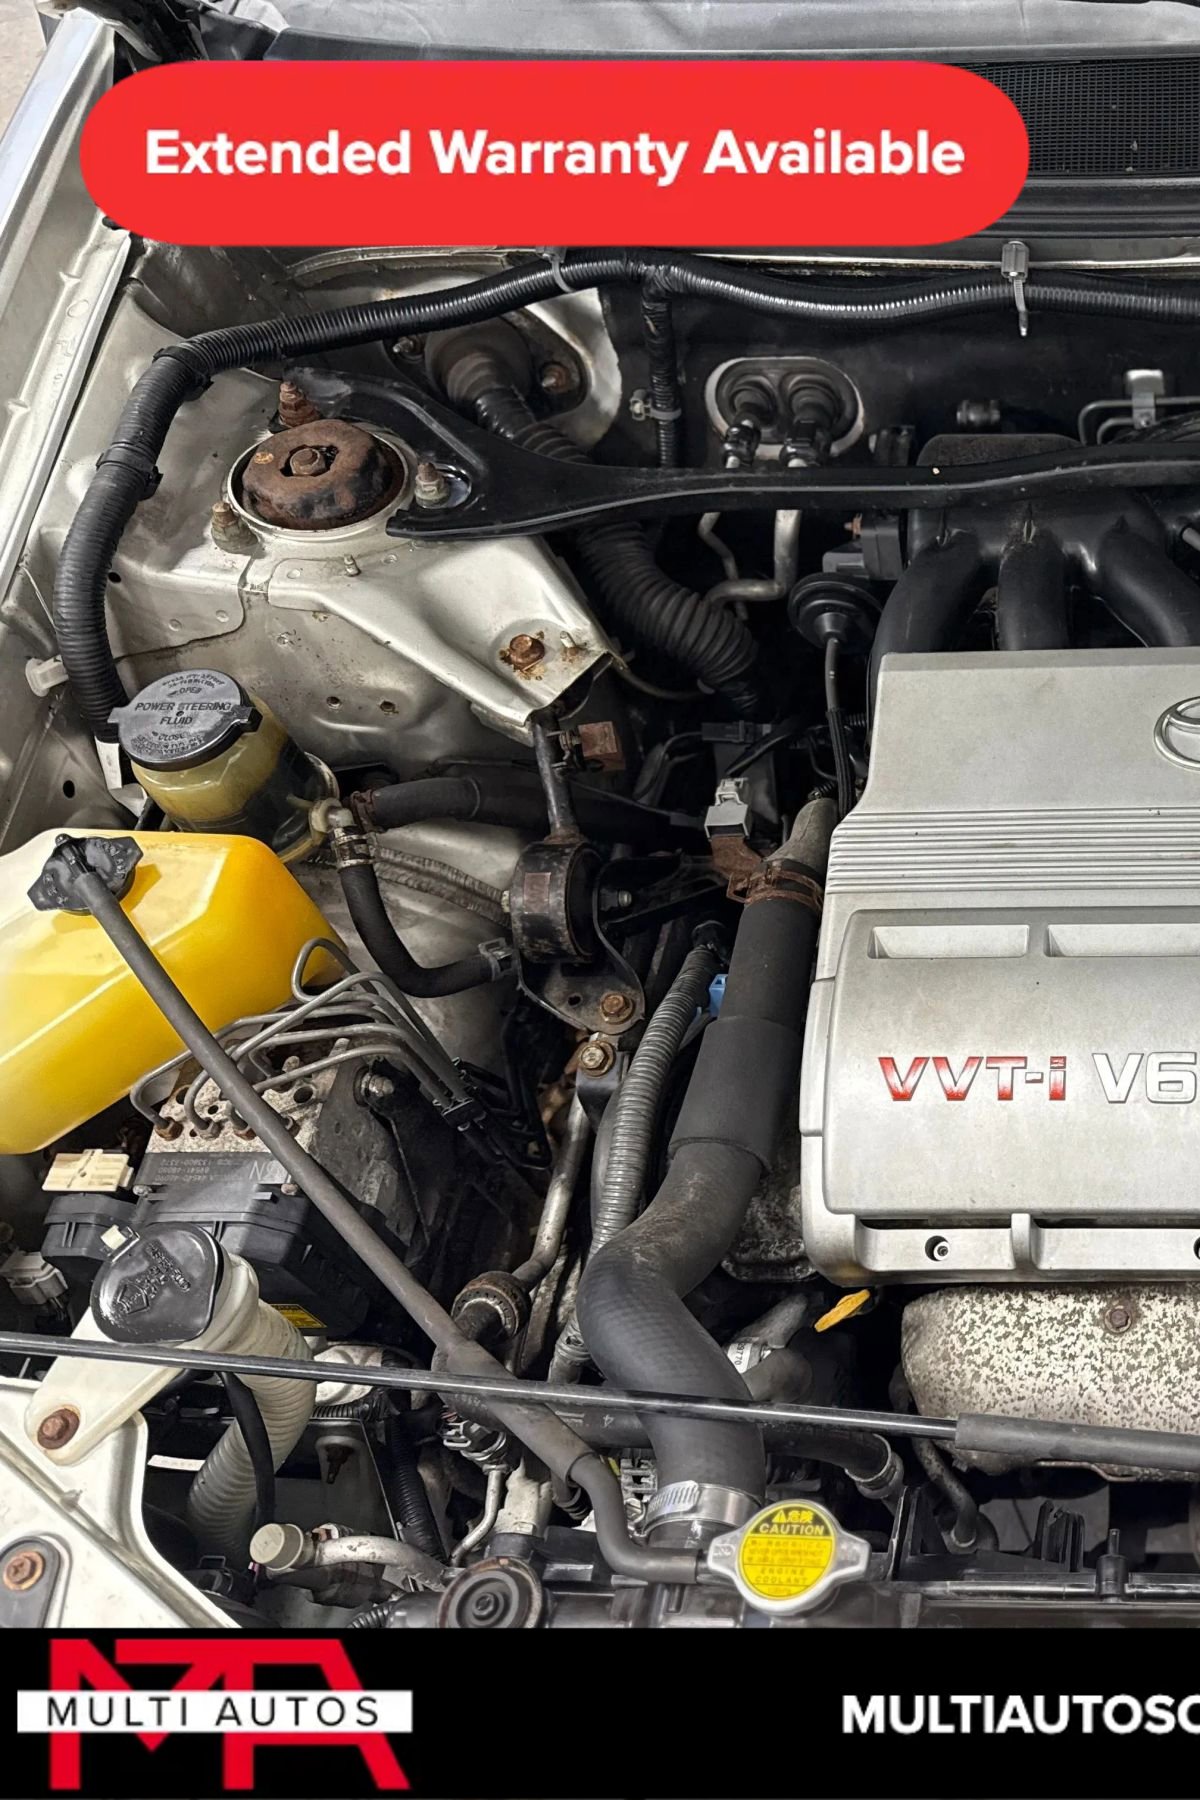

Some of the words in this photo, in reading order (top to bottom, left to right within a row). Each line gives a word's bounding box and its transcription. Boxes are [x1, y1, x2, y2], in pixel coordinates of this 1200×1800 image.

[135, 701, 175, 711] POWER
[177, 701, 232, 711] STEERING
[160, 716, 193, 725] FLUID
[878, 1056, 1067, 1101] VVT-i
[1091, 1052, 1197, 1104] V6
[759, 1522, 825, 1536] CAUTION
[760, 1567, 806, 1577] ENGINE
[754, 1575, 809, 1585] COOLANT
